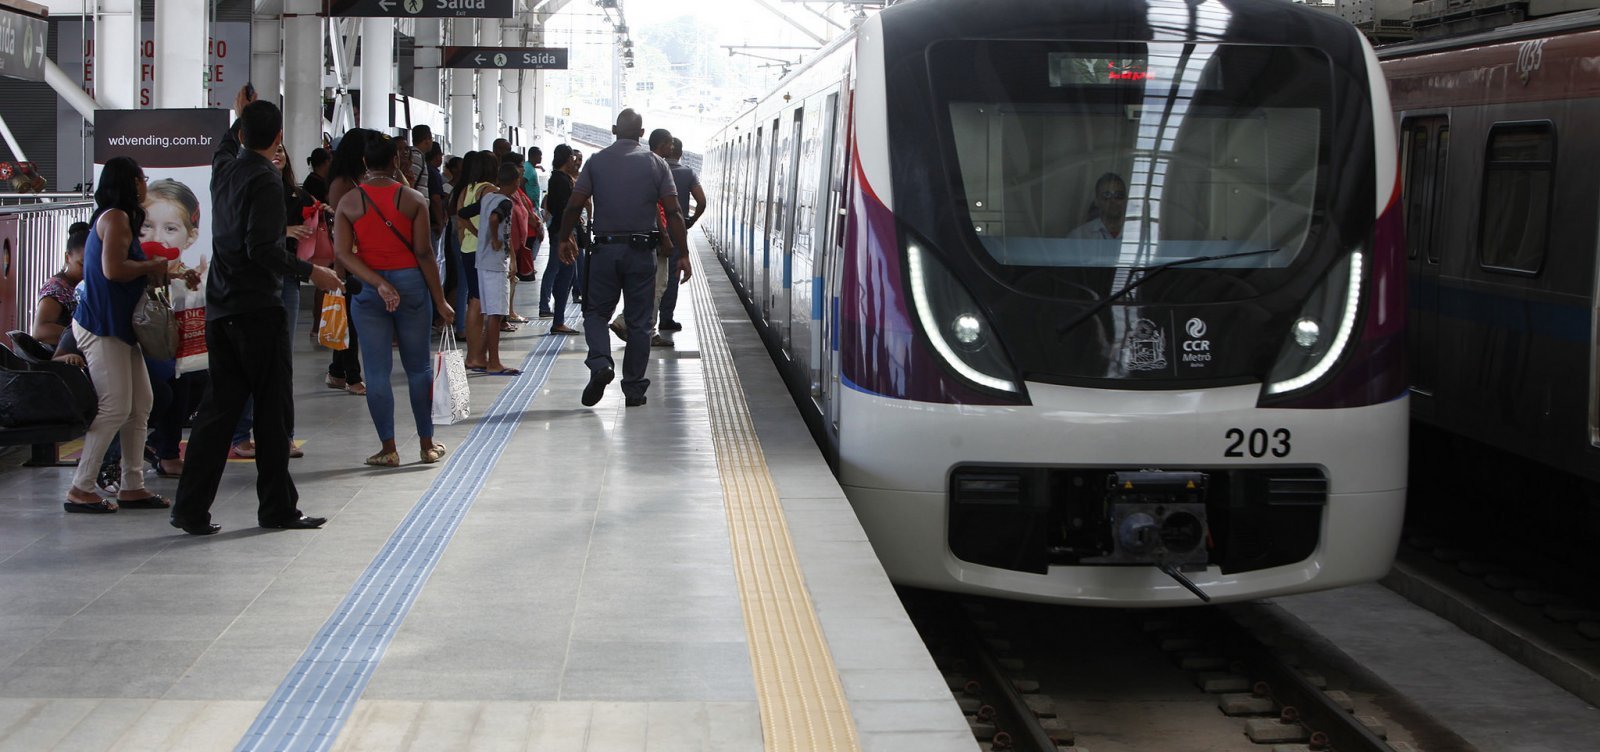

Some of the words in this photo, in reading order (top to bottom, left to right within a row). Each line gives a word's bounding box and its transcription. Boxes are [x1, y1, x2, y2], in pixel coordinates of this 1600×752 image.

[523, 53, 556, 64] Saída
[108, 134, 213, 148] wdvending.com.br
[1182, 340, 1210, 351] CCR
[1182, 352, 1212, 361] Metrô
[1224, 427, 1291, 458] 203
